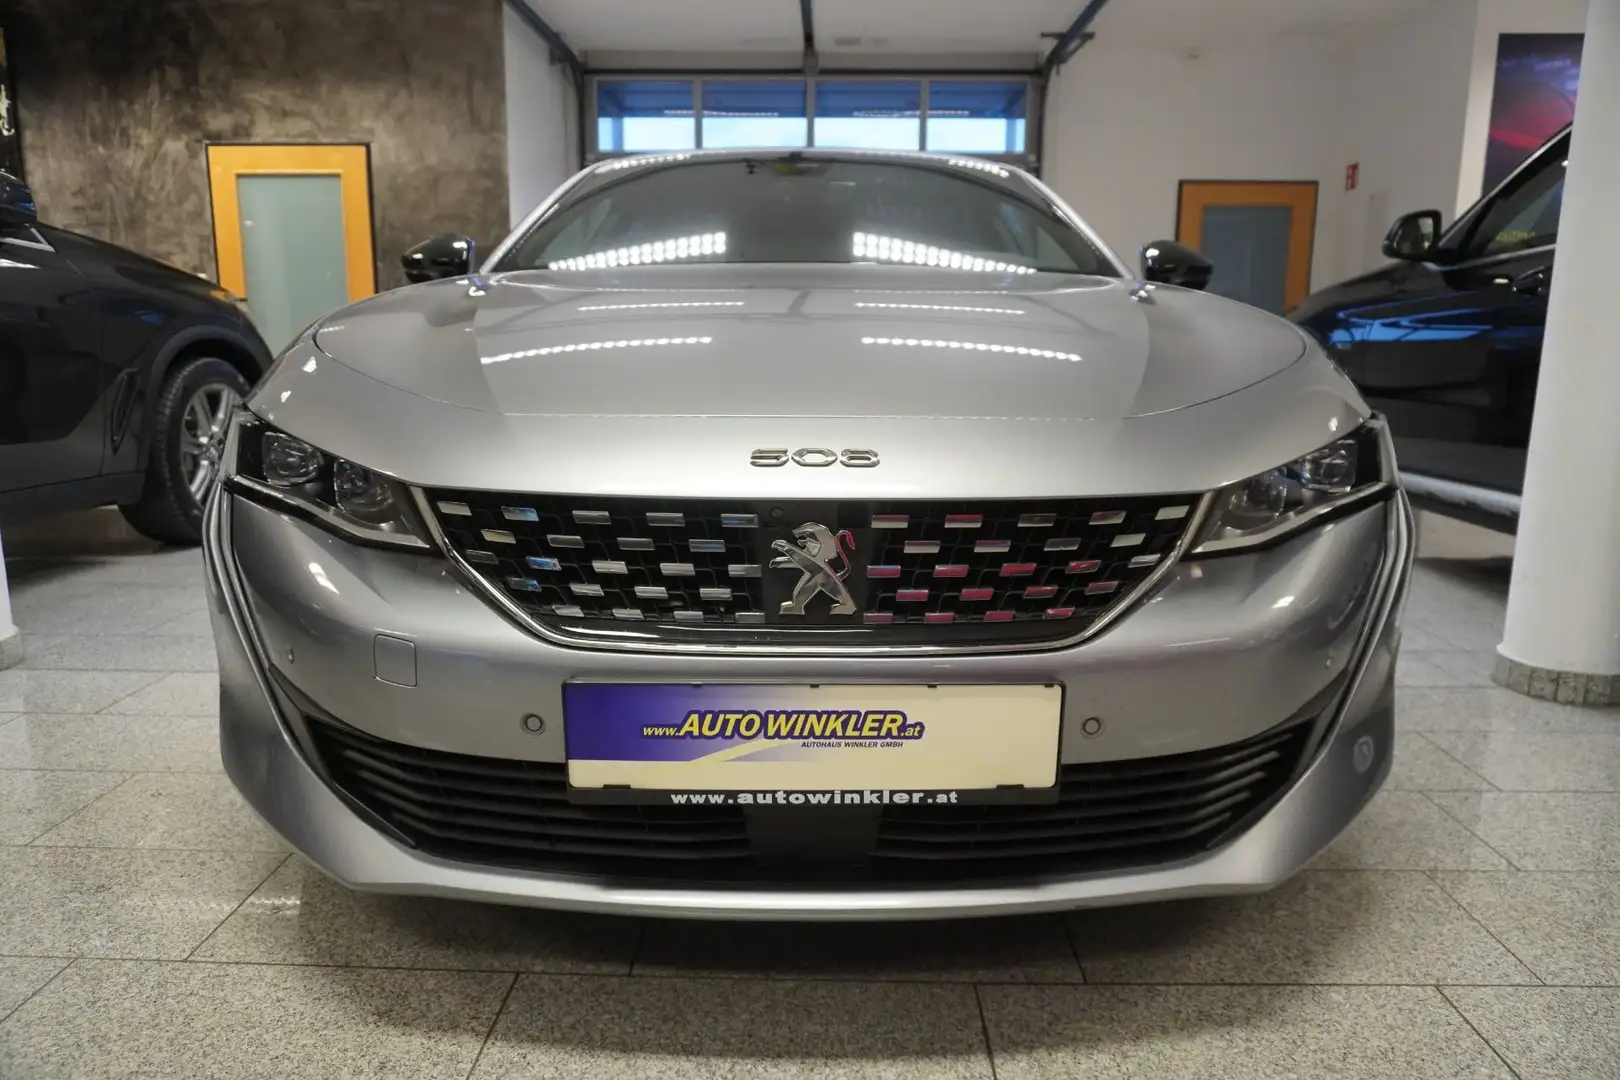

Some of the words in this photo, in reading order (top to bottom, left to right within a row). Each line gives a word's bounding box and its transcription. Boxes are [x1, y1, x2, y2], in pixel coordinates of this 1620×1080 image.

[749, 448, 881, 468] 508
[800, 741, 842, 749] AUTOHAUS
[843, 741, 878, 749] WINKLER
[880, 741, 904, 749] GMBH
[670, 789, 958, 805] www.autowinkler.at
